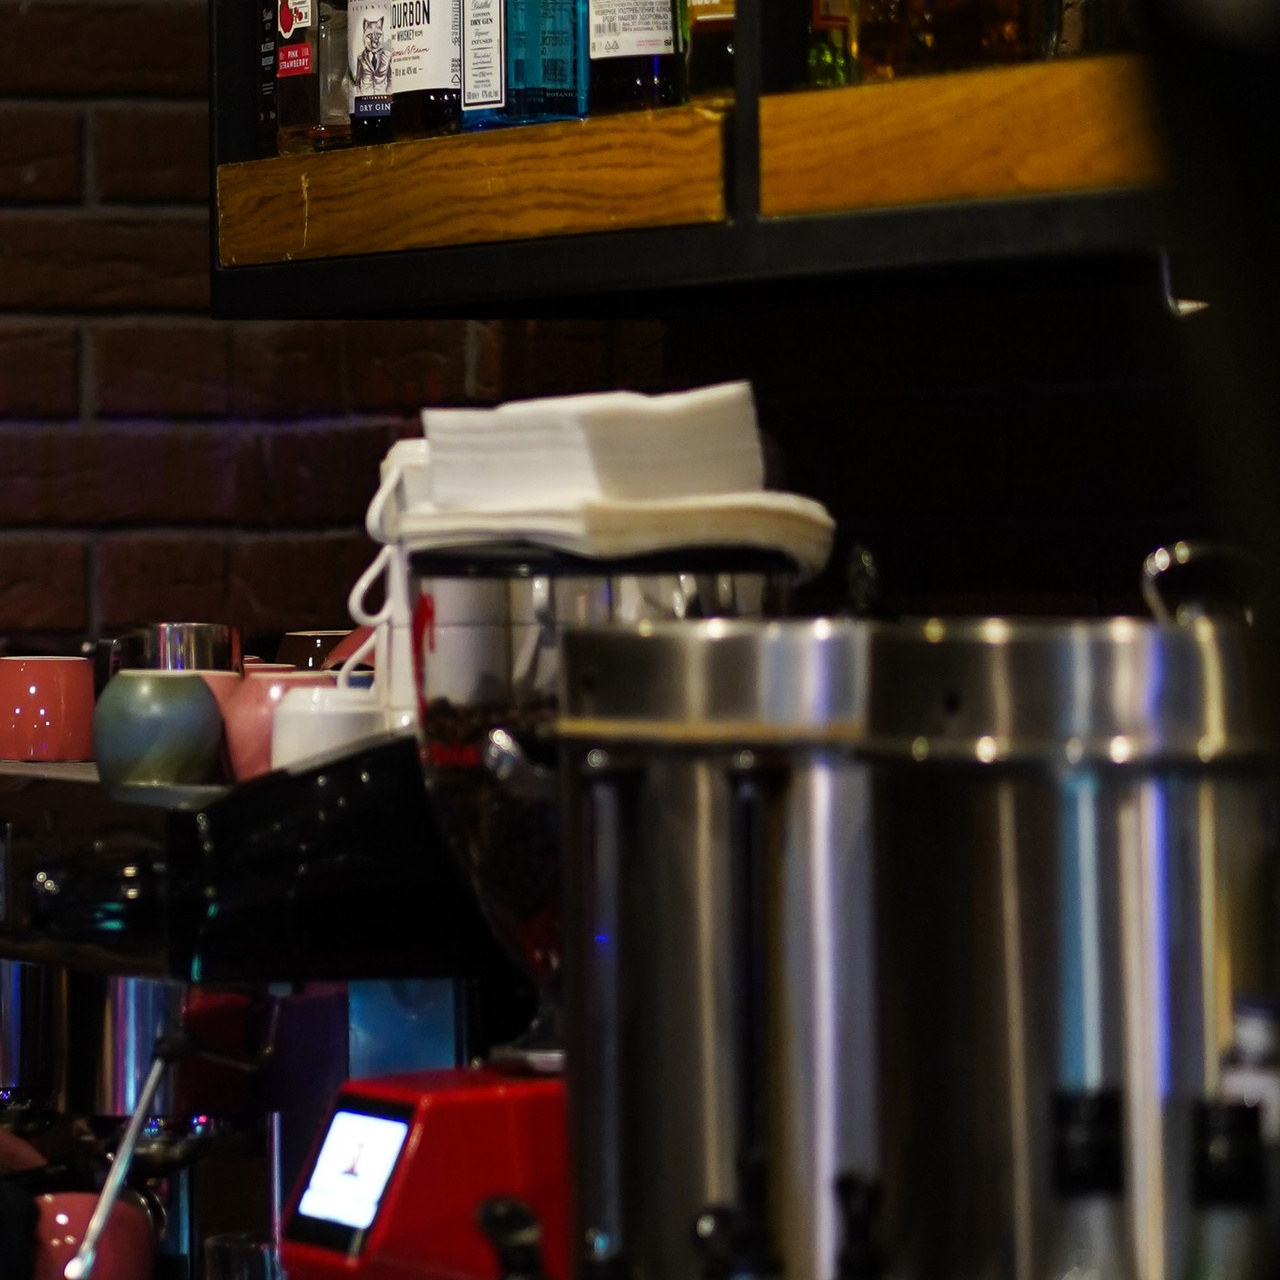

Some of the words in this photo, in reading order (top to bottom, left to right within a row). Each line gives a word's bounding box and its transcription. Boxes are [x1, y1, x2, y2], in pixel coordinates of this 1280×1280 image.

[389, 0, 430, 29] OURBON
[287, 49, 299, 59] PINK
[279, 57, 309, 71] STRAWBERRY
[359, 103, 373, 113] DRY
[375, 102, 392, 112] GIN
